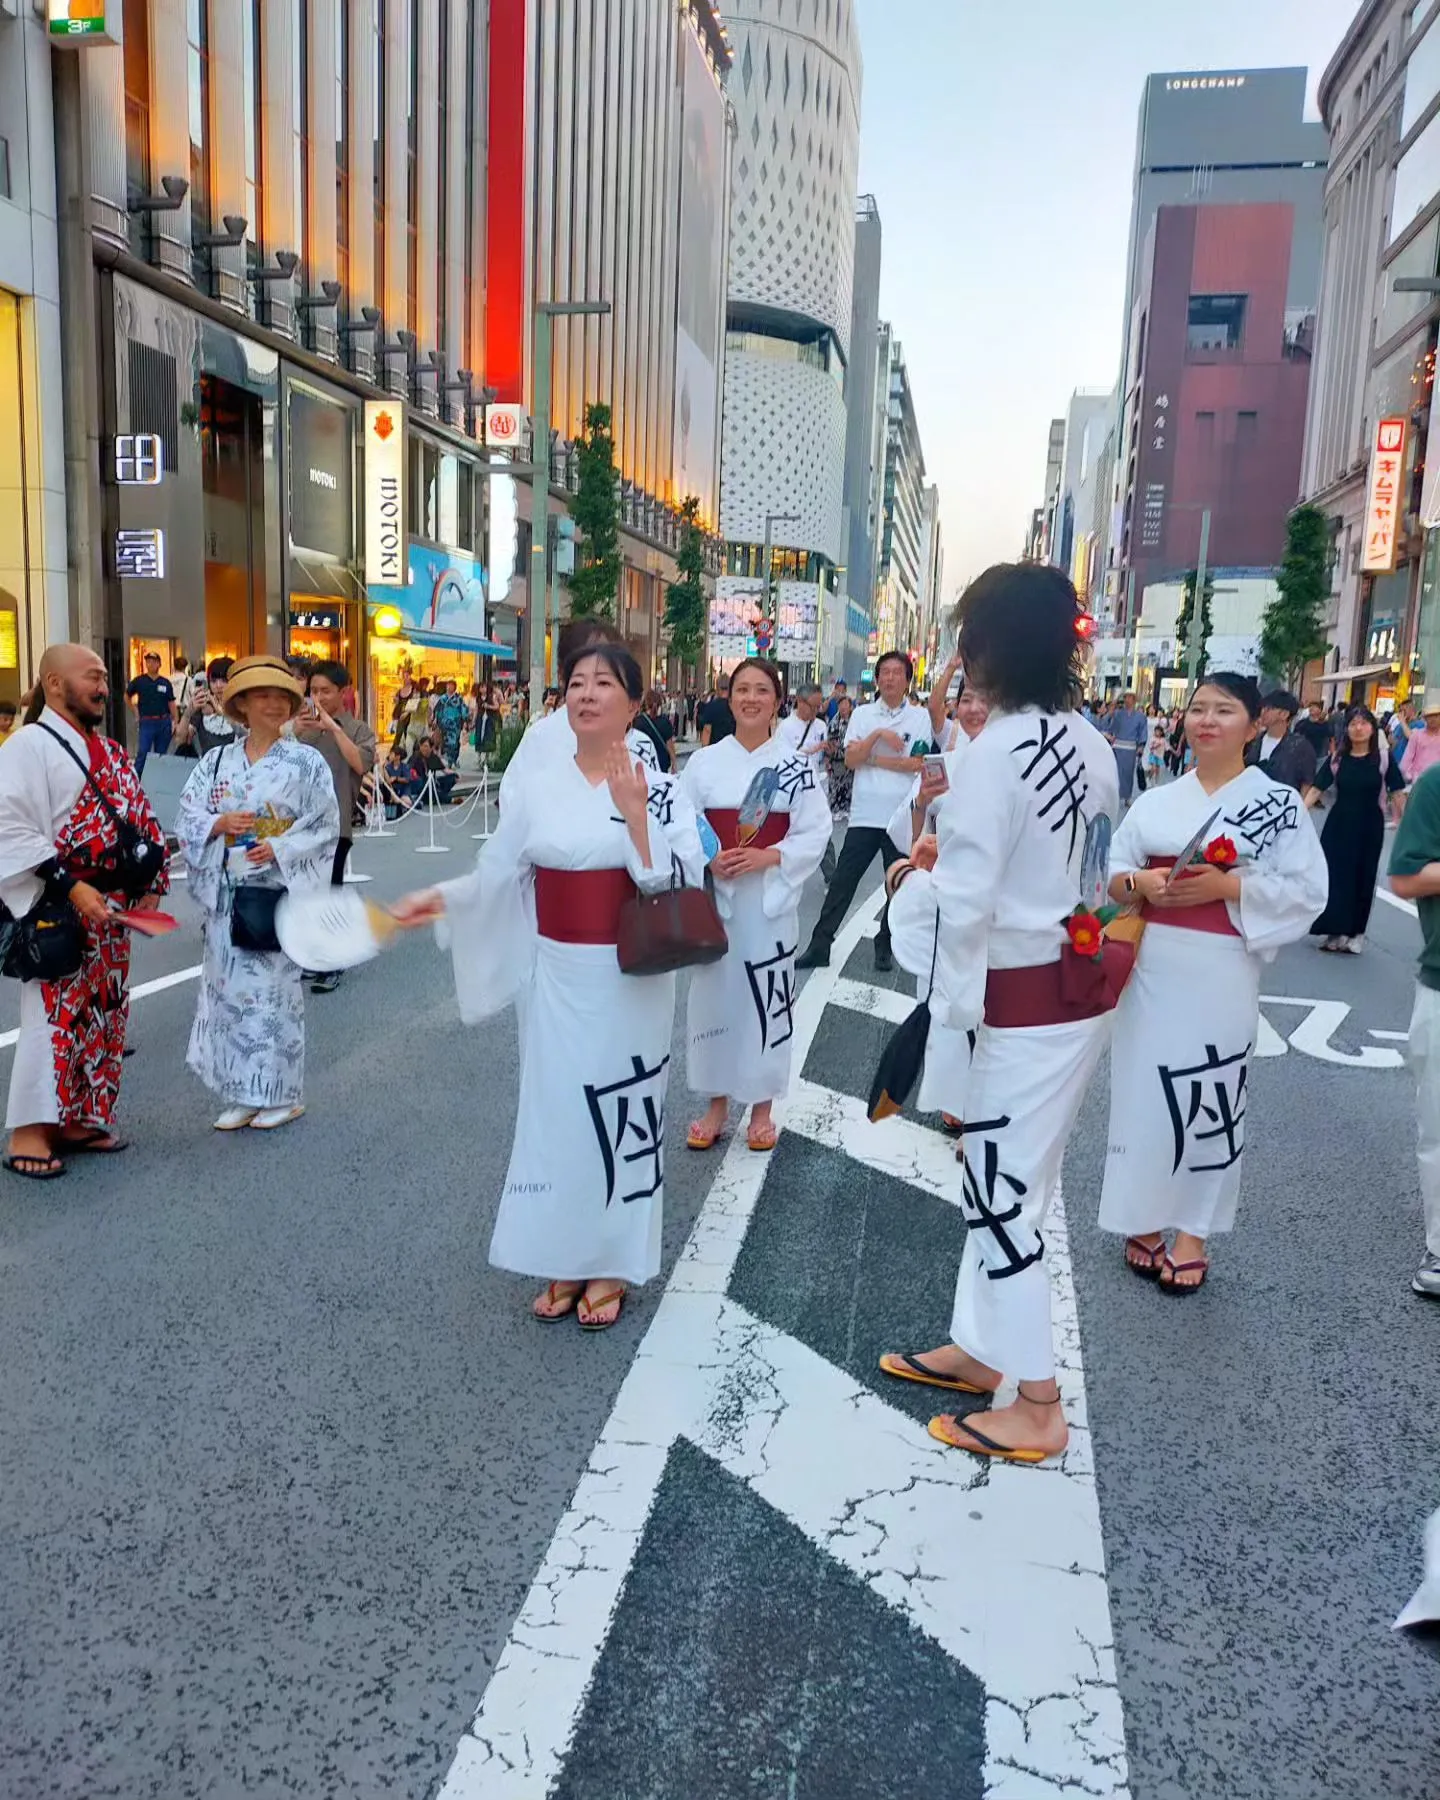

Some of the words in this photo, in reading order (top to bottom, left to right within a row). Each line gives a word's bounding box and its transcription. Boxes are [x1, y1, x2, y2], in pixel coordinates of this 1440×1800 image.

[67, 20, 91, 34] 3F
[1166, 76, 1246, 91] LONGCHAMP
[744, 941, 798, 1056] 座
[583, 1054, 670, 1211] 座
[1157, 1042, 1252, 1177] 座
